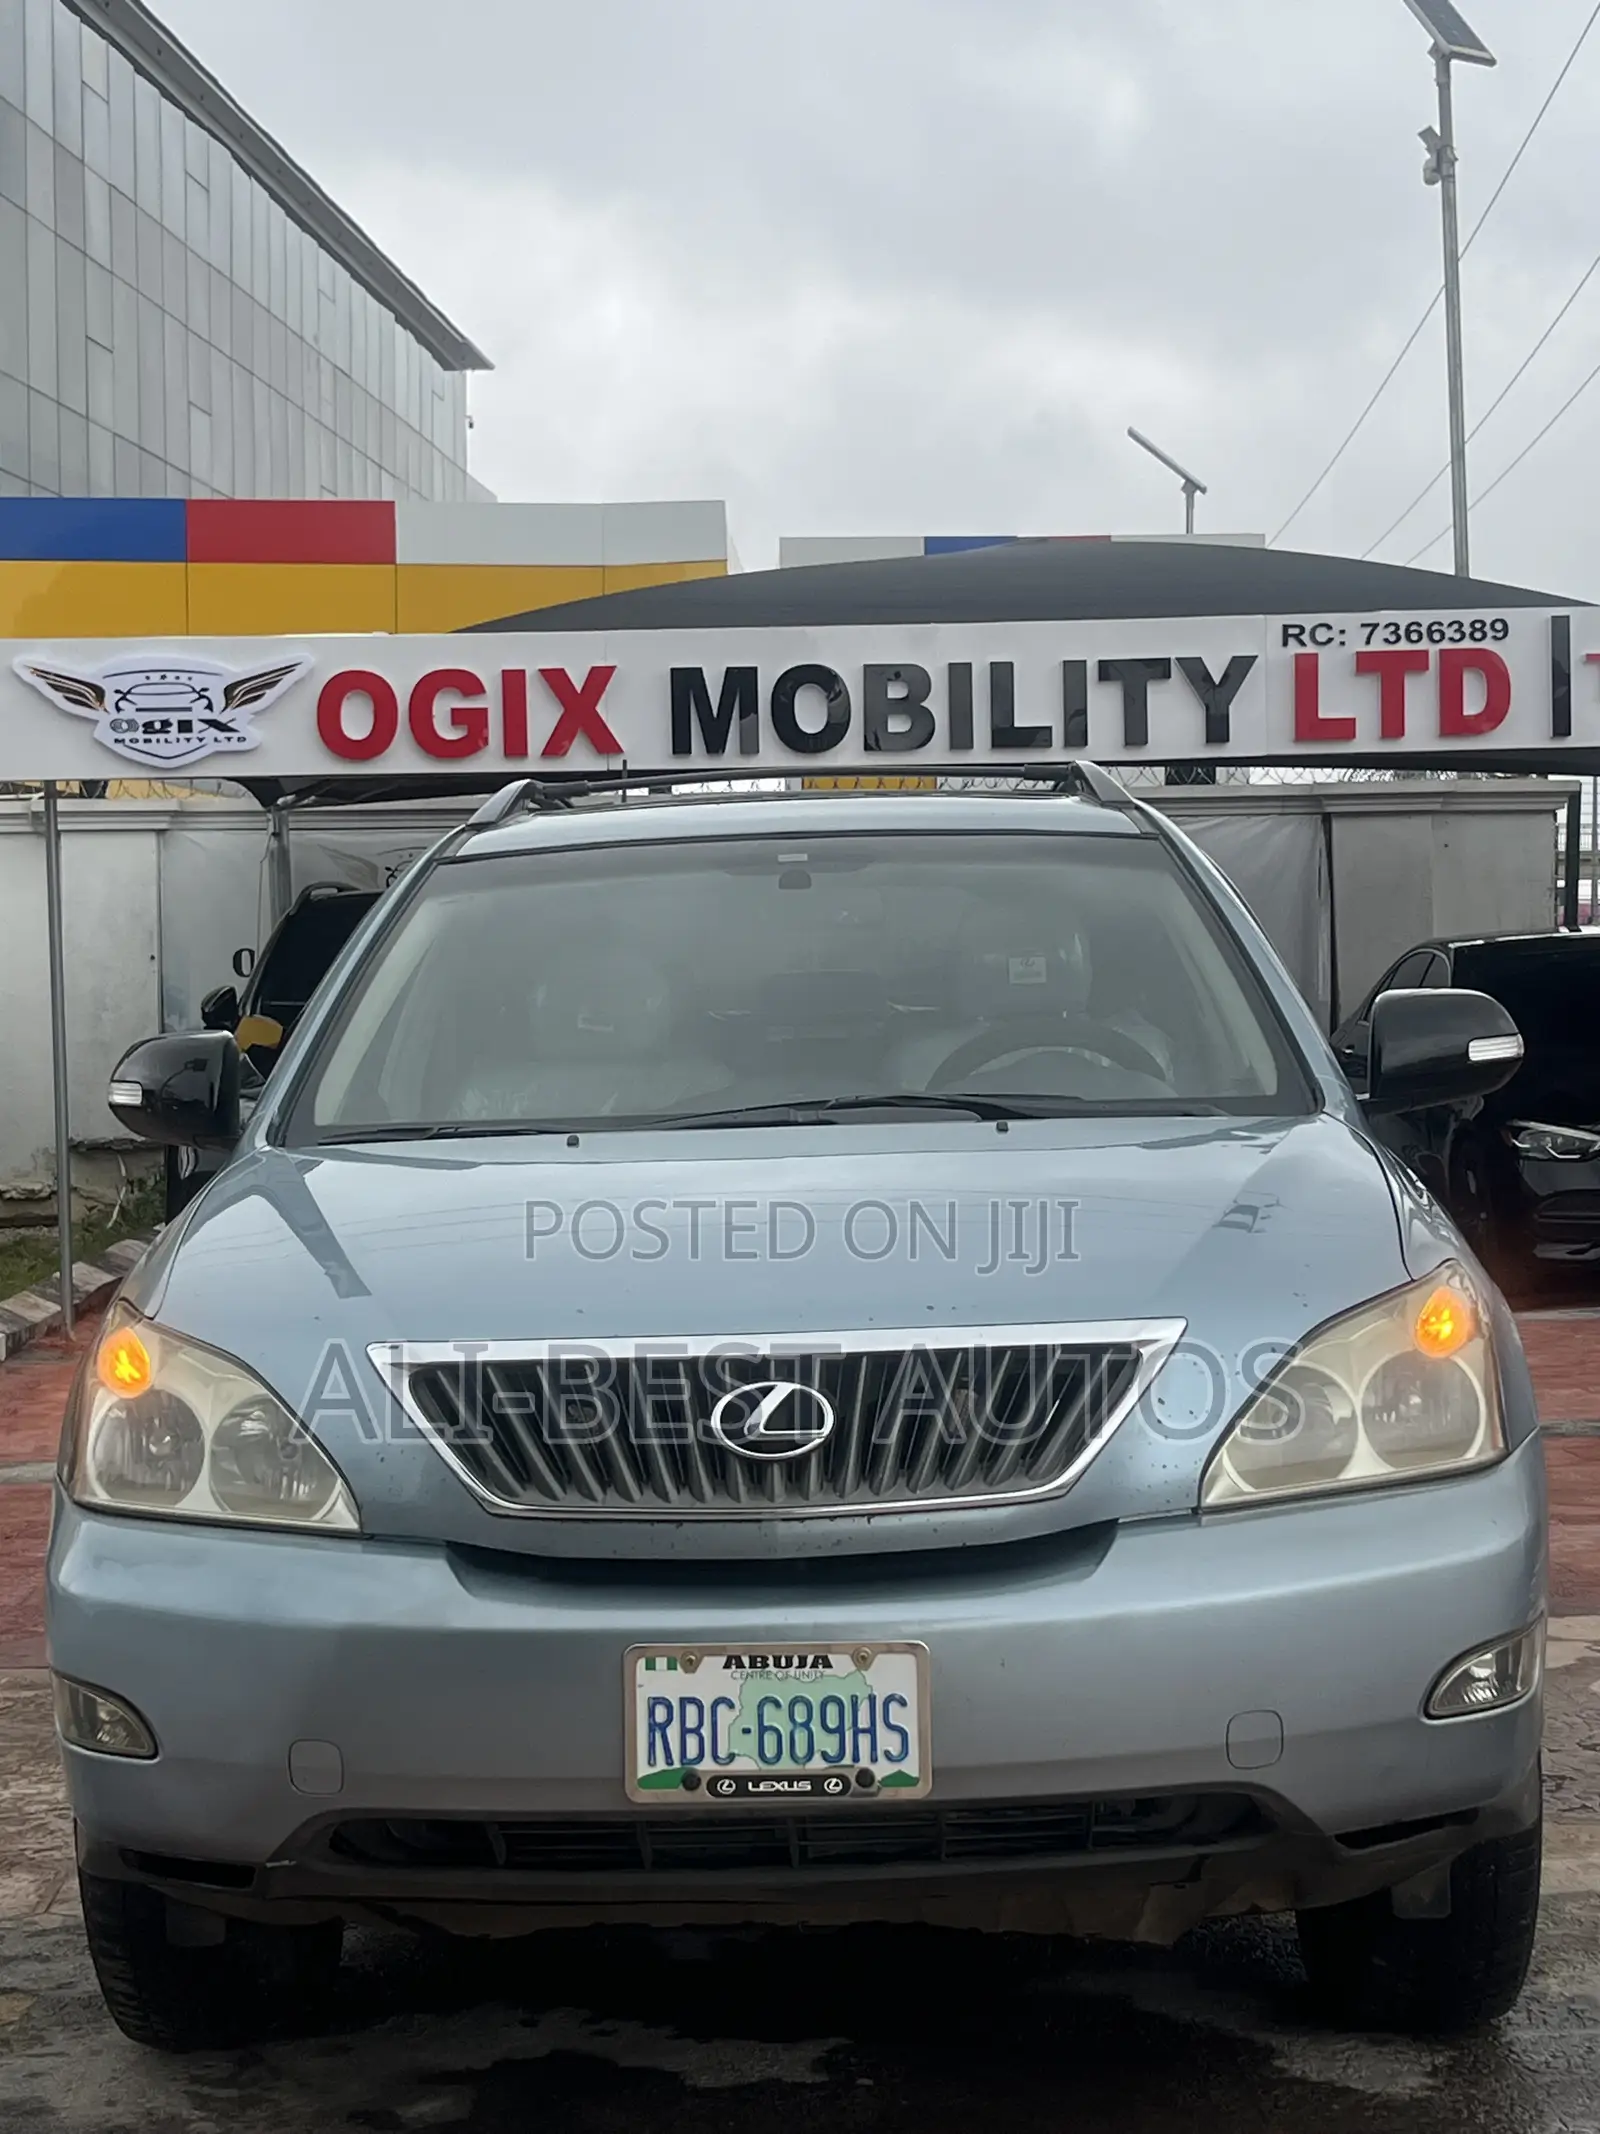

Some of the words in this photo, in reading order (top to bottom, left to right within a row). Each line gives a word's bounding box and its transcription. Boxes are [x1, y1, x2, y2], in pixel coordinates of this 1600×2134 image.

[1281, 623, 1346, 648] RC:
[1360, 618, 1510, 646] 7366389
[316, 665, 625, 760] OGIX
[669, 655, 1259, 755] MOBILITY
[1293, 647, 1512, 742] LTD
[113, 736, 207, 744] MOBILITY
[722, 1654, 834, 1669] ABUJA
[730, 1670, 772, 1681] CENTRE
[775, 1670, 791, 1681] OF
[794, 1670, 825, 1681] UNITY
[646, 1693, 910, 1767] RBC-689HS
[747, 1777, 812, 1792] LEXUS
